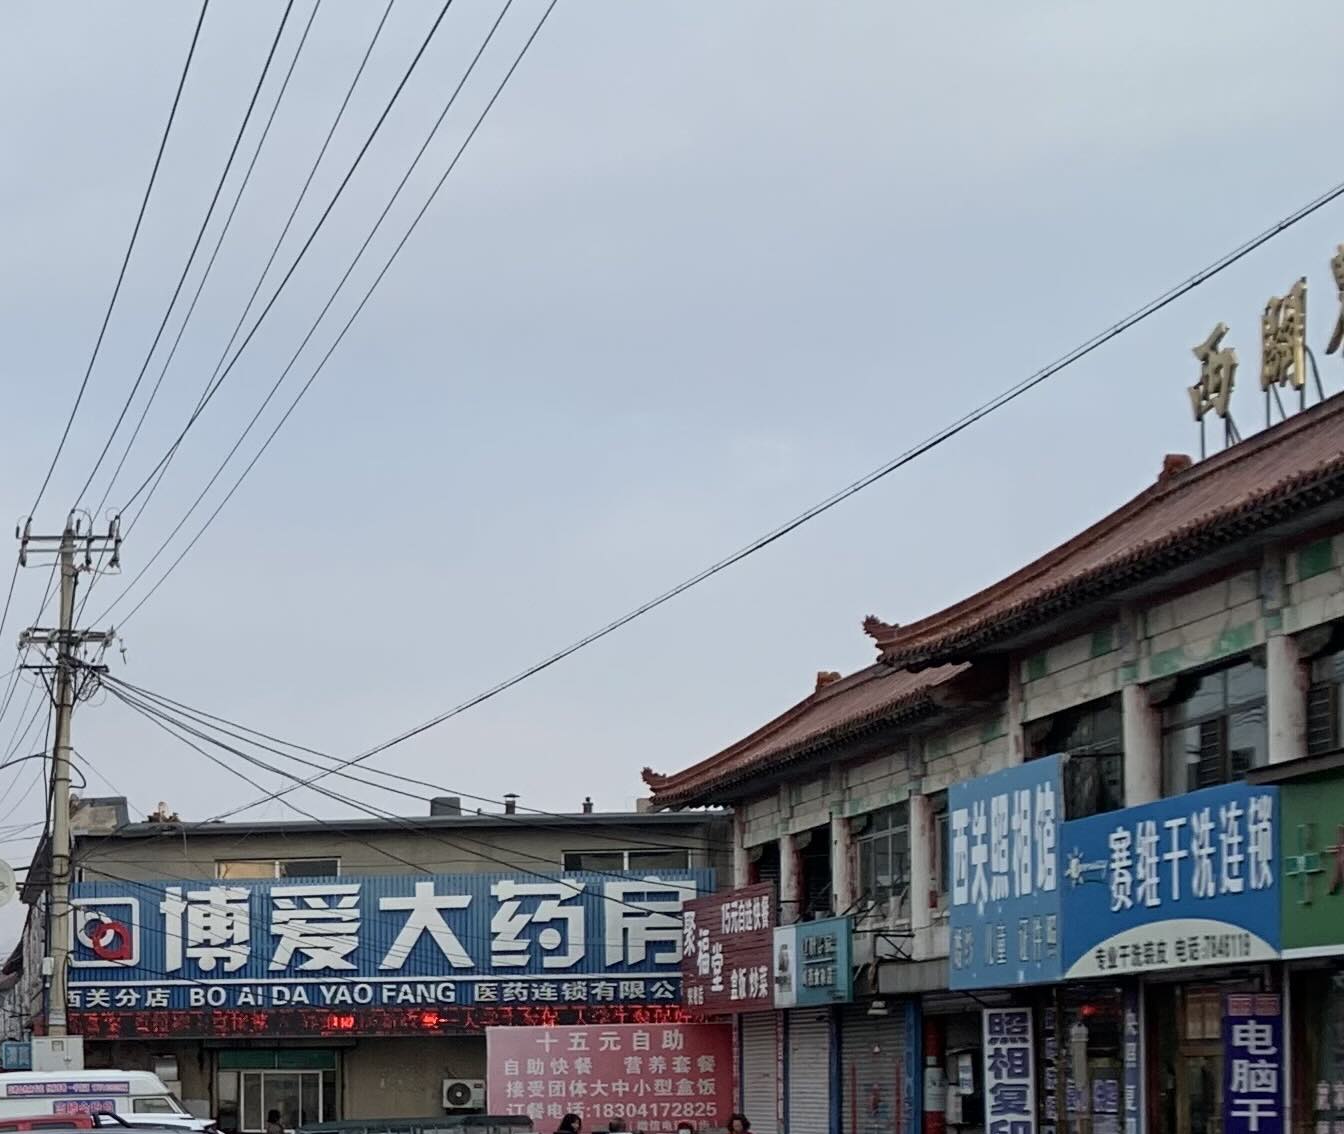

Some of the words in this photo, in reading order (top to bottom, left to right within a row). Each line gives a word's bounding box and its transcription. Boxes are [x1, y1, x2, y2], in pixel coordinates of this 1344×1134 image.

[952, 782, 1058, 907] 西关照相馆
[1108, 794, 1275, 912] 赛维干洗连锁
[160, 878, 697, 973] 博爱大药房
[189, 986, 226, 1007] BO
[237, 986, 263, 1006] AI
[272, 984, 310, 1006] DA
[319, 983, 374, 1006] YAO
[382, 982, 456, 1004] FANG
[474, 980, 683, 1002] 医药连锁有限公
[535, 1029, 685, 1053] 十五元自助
[504, 1056, 594, 1077] 自助快餐
[623, 1054, 717, 1076] 营养套餐
[506, 1077, 717, 1099] 接受团体大中小型盒饭
